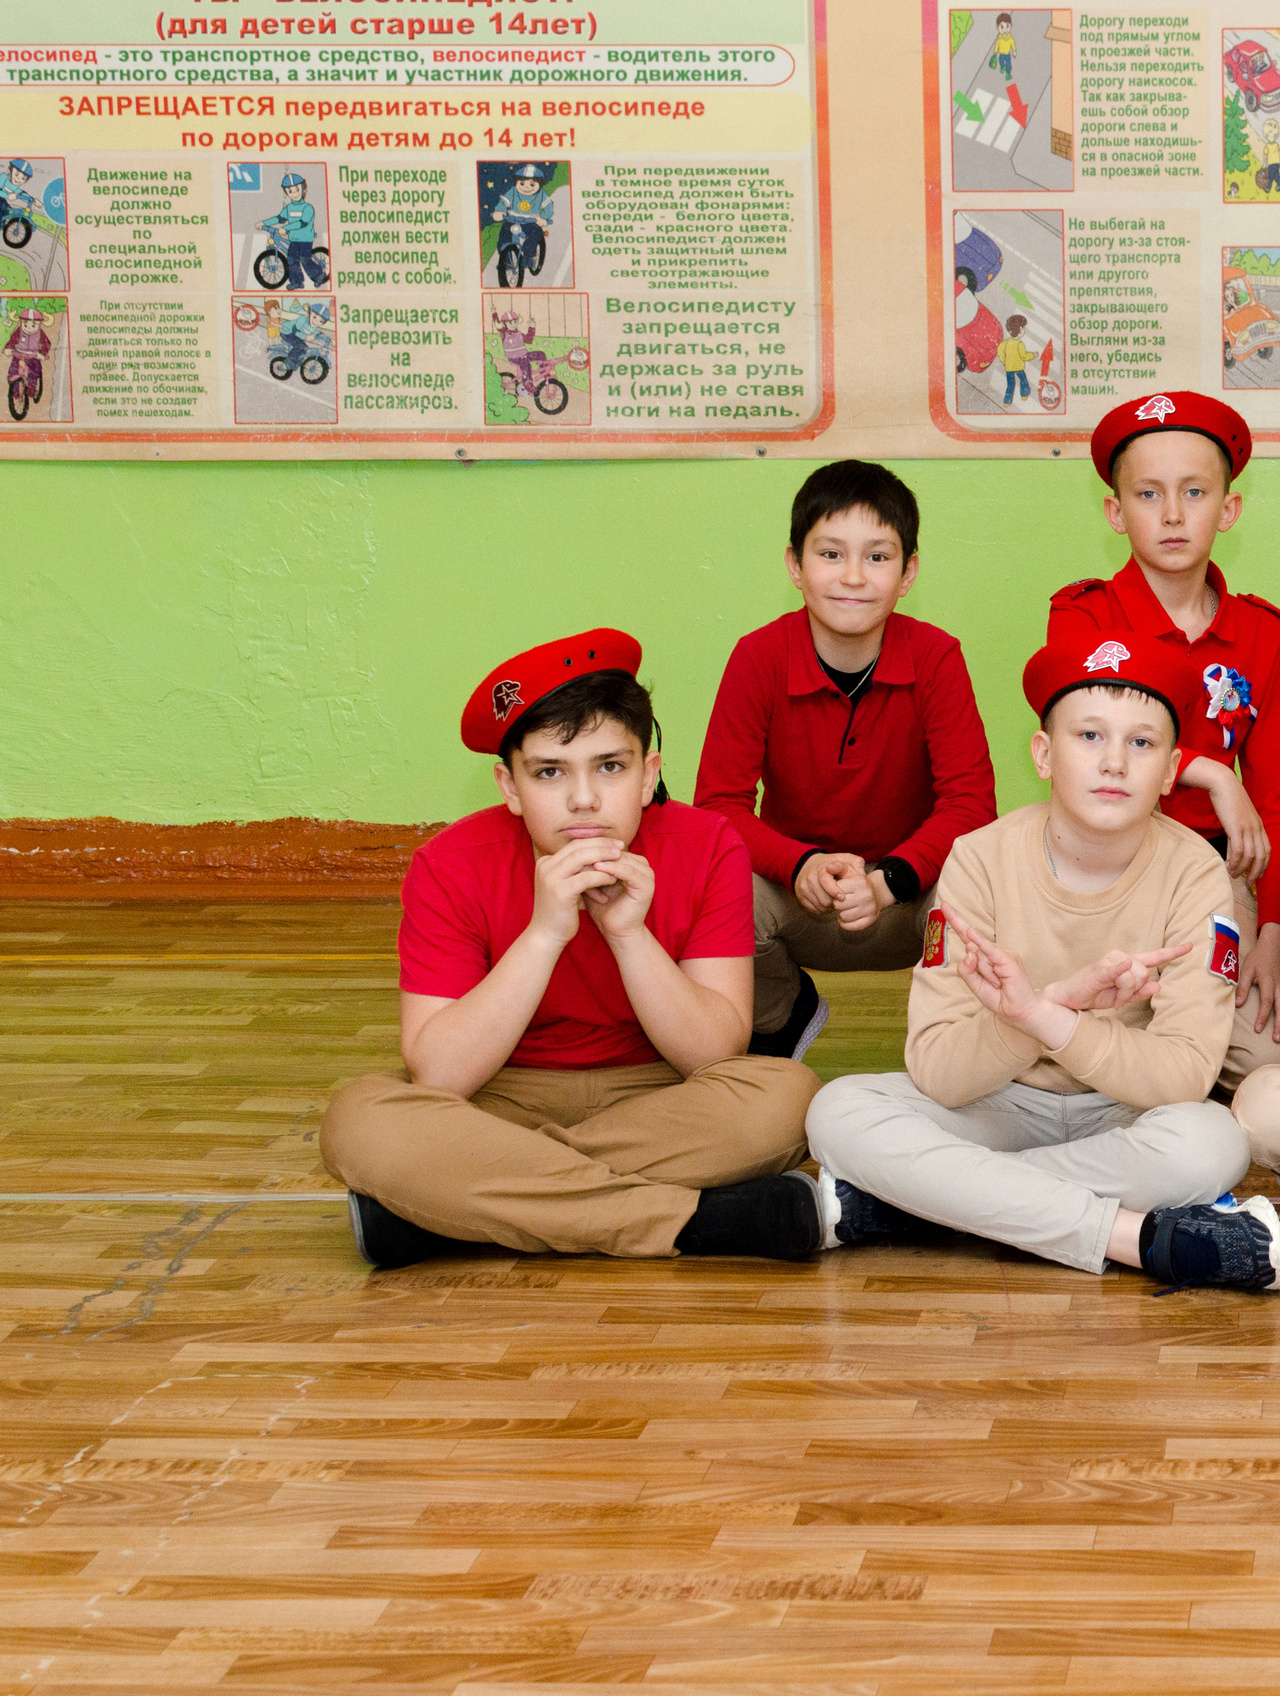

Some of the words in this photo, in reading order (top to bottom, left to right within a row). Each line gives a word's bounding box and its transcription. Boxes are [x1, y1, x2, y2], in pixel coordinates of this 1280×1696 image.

[156, 12, 227, 40] (для
[240, 12, 336, 38] детей
[350, 17, 475, 40] старше
[489, 11, 597, 40] 14лет)
[1079, 14, 1125, 29] Дорогу
[1129, 16, 1188, 28] переходи
[1080, 31, 1103, 43] под
[1108, 32, 1159, 44] прямым
[1164, 31, 1200, 44] углом
[119, 49, 153, 62] это
[160, 49, 310, 65] транспортное
[319, 49, 424, 65] средство,
[433, 50, 586, 64] велосипедист
[608, 50, 710, 64] водитель
[719, 50, 775, 62] этого
[1080, 47, 1086, 56] к
[1090, 44, 1150, 58] проезжей
[1155, 46, 1193, 56] части.
[1081, 59, 1126, 71] Нельзя
[1131, 61, 1204, 73] переходить
[6, 68, 167, 86] транспортного
[174, 68, 279, 86] средства,
[288, 68, 298, 81] а
[306, 68, 378, 81] значит
[386, 69, 397, 81] и
[405, 69, 502, 86] участник
[509, 69, 627, 86] дорожного
[634, 69, 747, 83] движения.
[1080, 77, 1124, 89] дорогу
[1129, 77, 1196, 86] наискосок.
[59, 95, 274, 118] ЗАПРЕЩАЕТСЯ
[285, 100, 490, 119] передвигаться
[502, 100, 531, 116] на
[542, 101, 705, 118] велосипеде
[182, 131, 213, 147] по
[222, 131, 338, 151] дорогам
[347, 131, 429, 150] детям
[439, 132, 473, 150] до
[484, 127, 512, 147] 14
[522, 127, 575, 147] лет!
[87, 167, 168, 182] Движение
[174, 170, 192, 180] на
[339, 165, 368, 186] При
[374, 169, 447, 185] переходе
[604, 165, 636, 177] При
[643, 167, 769, 177] передвижении
[93, 185, 188, 196] велосипеде
[679, 179, 731, 189] время
[738, 179, 784, 190] суток
[342, 189, 386, 206] через
[391, 189, 445, 207] дорогу
[582, 190, 674, 199] велосипед
[680, 190, 744, 199] должен
[750, 186, 794, 198] быть
[110, 200, 172, 211] должно
[585, 199, 689, 213] оборудован
[695, 200, 789, 211] фонарями:
[75, 214, 208, 227] осуществляться
[340, 210, 450, 225] велосипедист
[1069, 217, 1085, 230] Не
[1090, 216, 1145, 230] выбегай
[1150, 220, 1165, 230] на
[132, 229, 152, 239] по
[341, 230, 400, 246] должен
[405, 230, 449, 243] вести
[89, 244, 196, 254] специальной
[85, 258, 202, 270] велосипедной
[355, 250, 439, 266] велосипед
[109, 273, 182, 285] дорожке.
[337, 270, 386, 287] рядом
[392, 270, 400, 284] с
[405, 268, 456, 284] собой.
[606, 297, 795, 316] Велосипедисту
[340, 303, 458, 326] Запрещается
[623, 322, 779, 336] запрещается
[348, 330, 452, 348] перевозить
[617, 343, 749, 357] двигаться,
[759, 342, 785, 354] не
[390, 351, 411, 366] на
[599, 363, 703, 378] держась
[713, 363, 736, 375] за
[746, 363, 803, 379] руль
[347, 373, 454, 391] велосипеде
[608, 384, 621, 396] и
[630, 381, 691, 400] (или)
[701, 384, 727, 396] не
[736, 384, 804, 396] ставя
[344, 394, 458, 412] пассажиров.
[606, 405, 659, 417] ноги
[669, 405, 695, 417] на
[705, 405, 800, 419] педаль.
